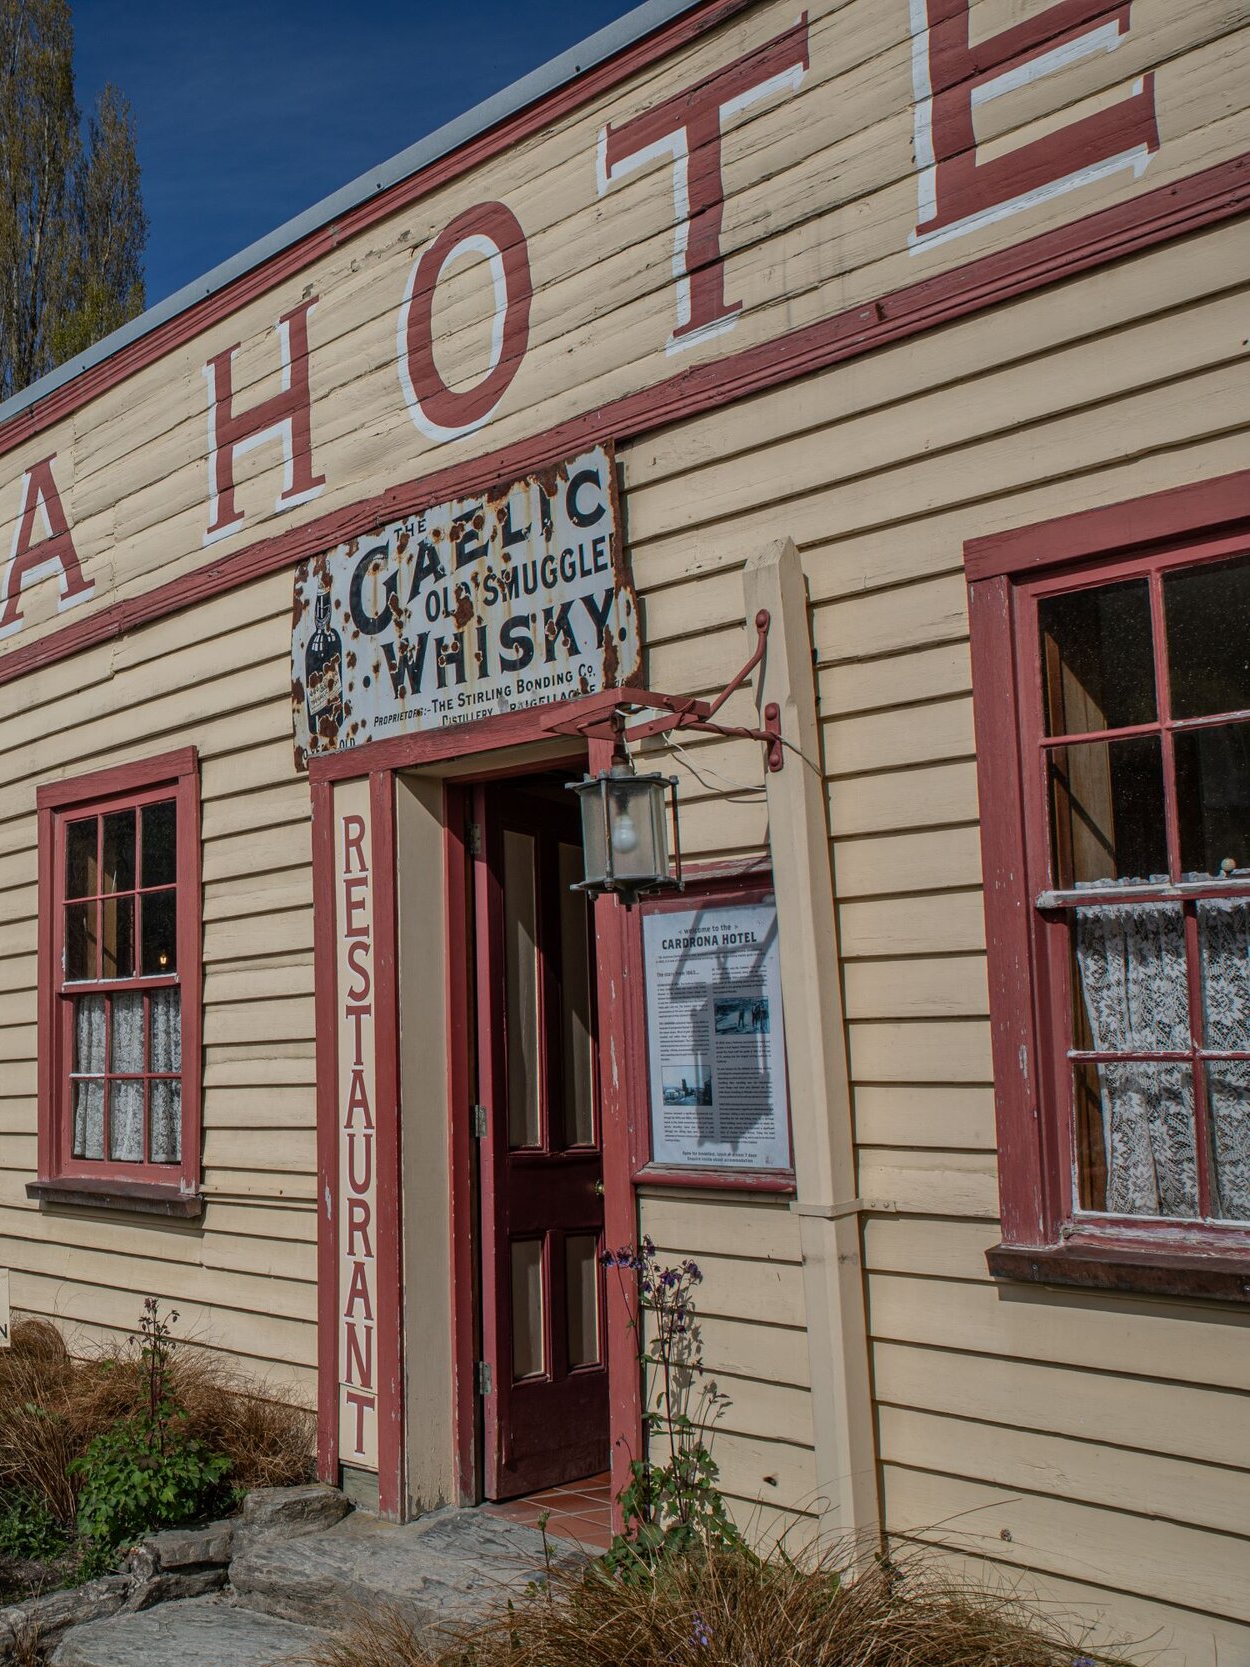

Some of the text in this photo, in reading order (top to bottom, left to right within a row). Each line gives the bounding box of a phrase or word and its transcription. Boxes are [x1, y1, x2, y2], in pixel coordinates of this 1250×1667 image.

[202, 0, 1160, 547] HOTE
[349, 468, 606, 636] GAELIC
[394, 518, 427, 542] THE
[483, 532, 615, 606] SMUGGLE
[381, 586, 615, 699] WHISKY
[458, 686, 511, 708] STIRLING
[517, 671, 573, 694] BONDING
[662, 931, 757, 950] CARDRONA HOTEL
[683, 923, 732, 934] welcome to the
[341, 814, 376, 1456] RESTAURANT
